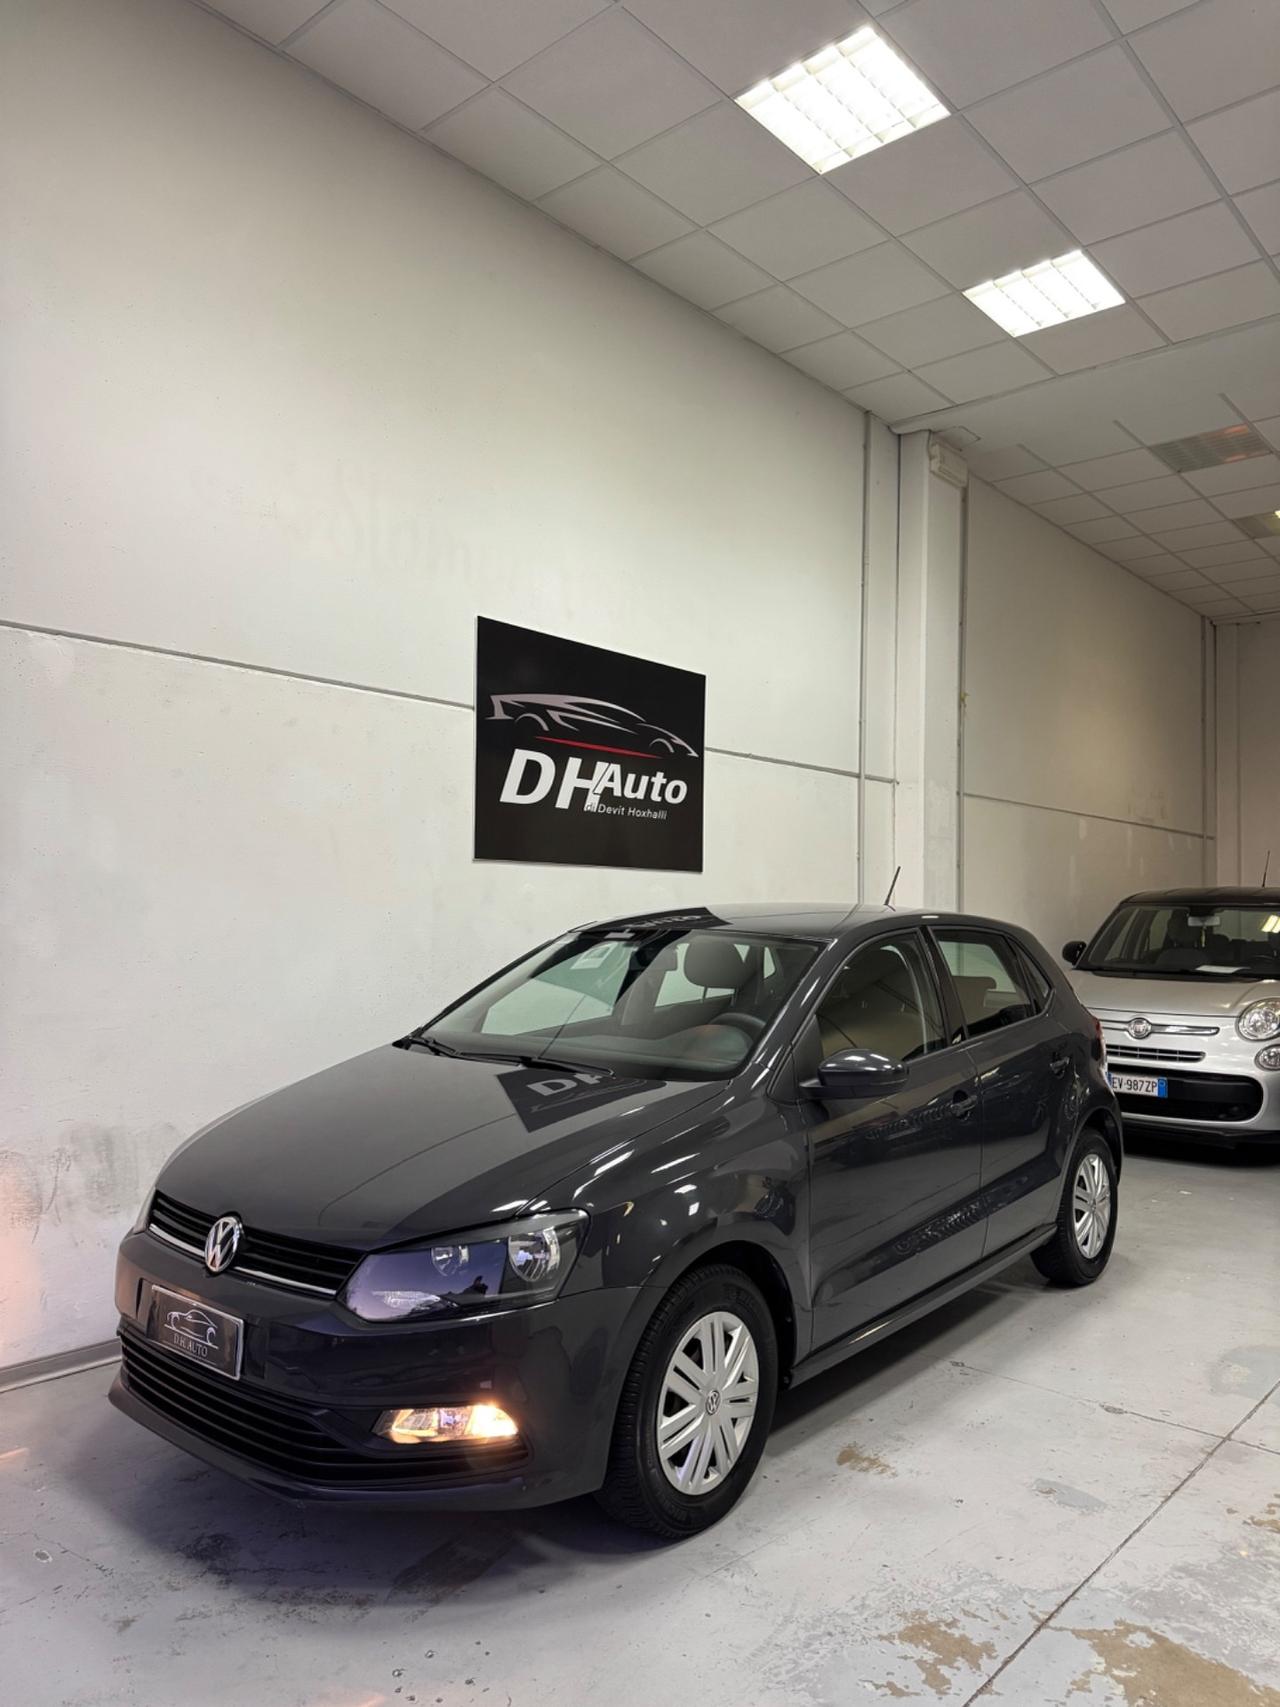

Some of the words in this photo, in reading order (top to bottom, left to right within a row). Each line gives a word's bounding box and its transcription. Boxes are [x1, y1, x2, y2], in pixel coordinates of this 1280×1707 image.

[593, 761, 688, 804] Auto
[598, 803, 625, 816] Devit
[187, 1340, 208, 1358] AUTO
